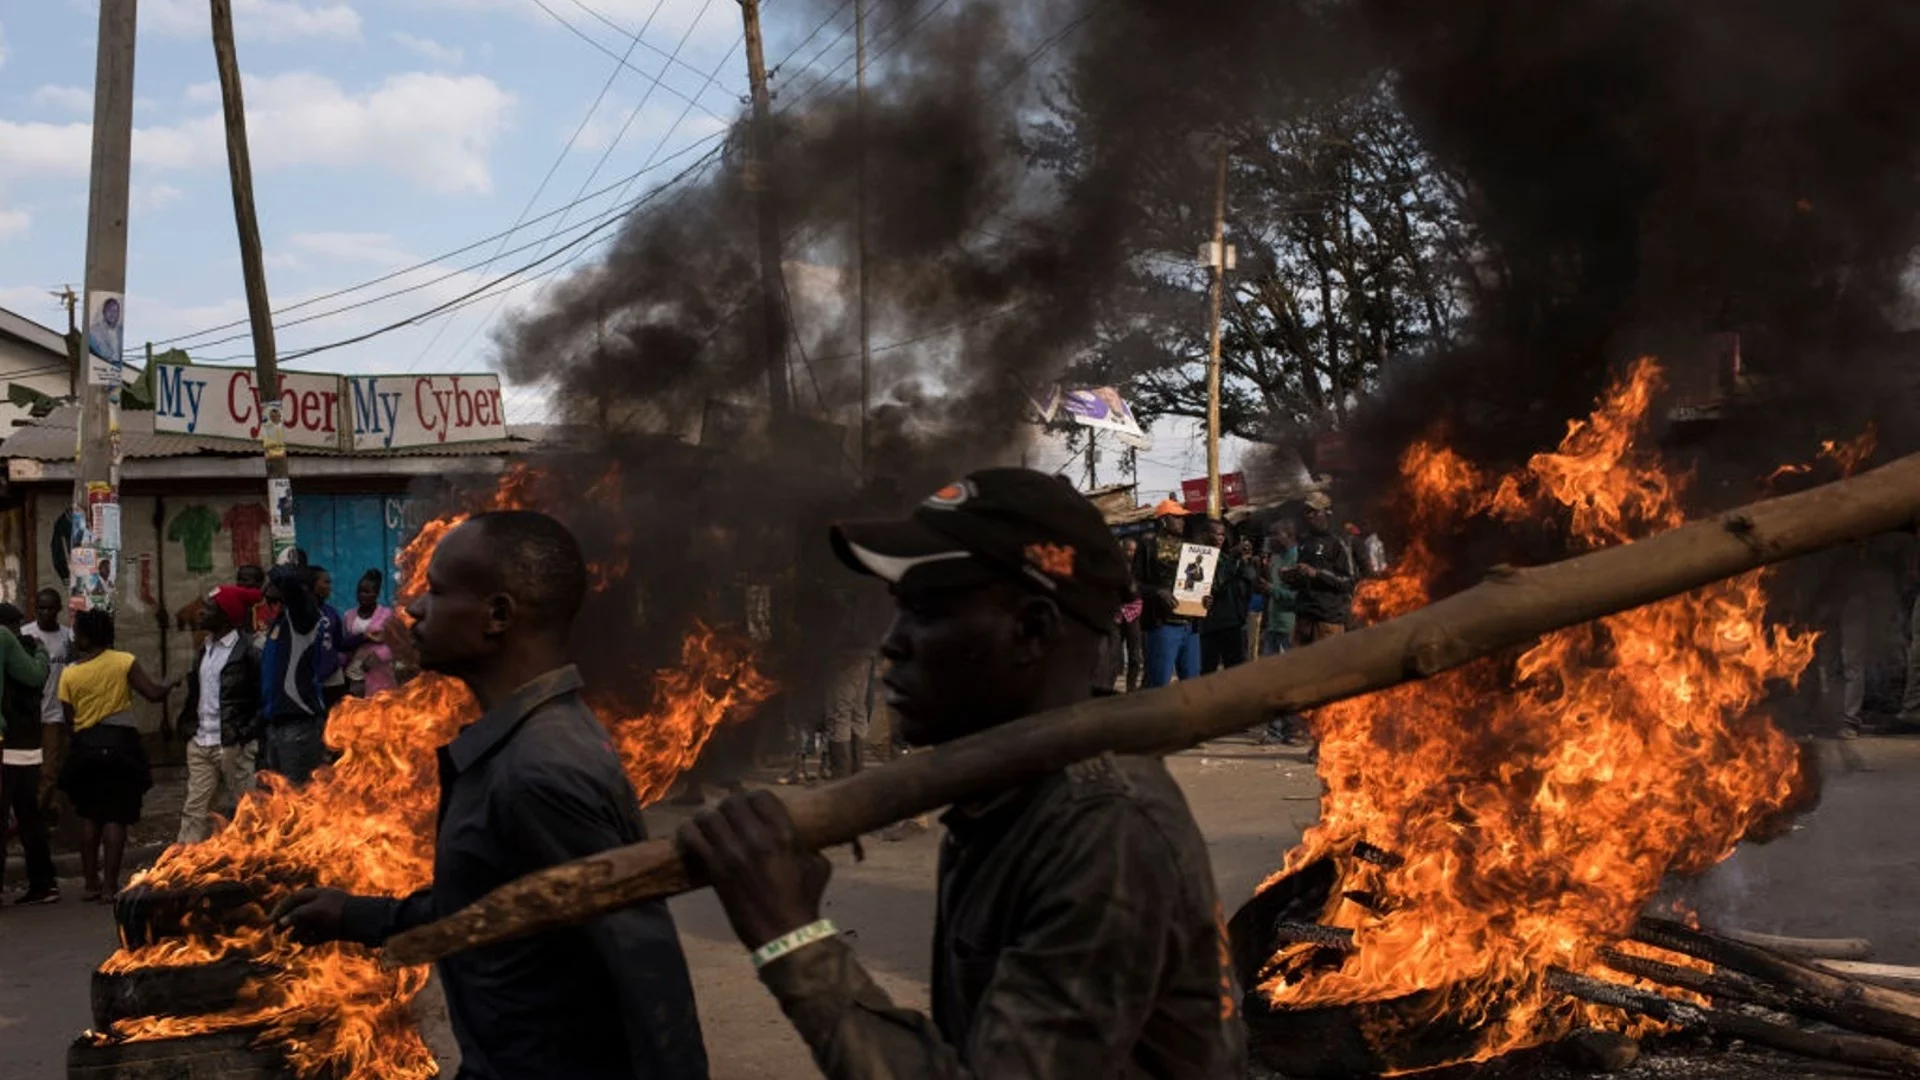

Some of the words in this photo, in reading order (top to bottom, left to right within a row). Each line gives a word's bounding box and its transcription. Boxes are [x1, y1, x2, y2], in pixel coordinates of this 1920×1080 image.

[157, 365, 207, 433] My
[228, 371, 338, 439] Cyber
[350, 377, 402, 448] My
[415, 376, 502, 442] Cyber
